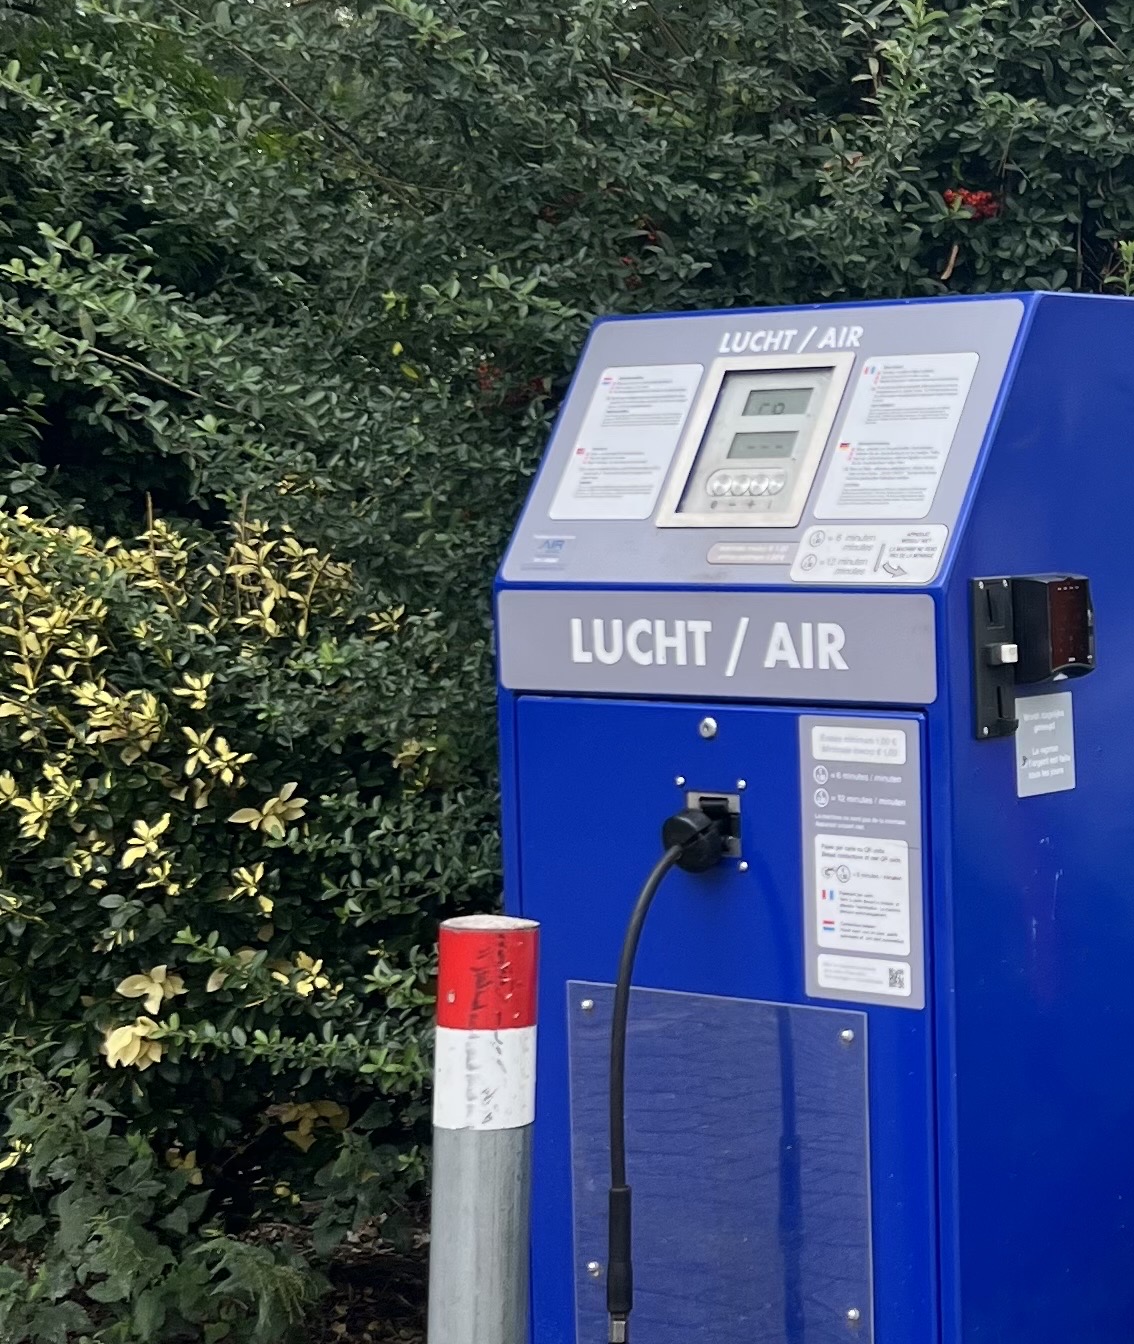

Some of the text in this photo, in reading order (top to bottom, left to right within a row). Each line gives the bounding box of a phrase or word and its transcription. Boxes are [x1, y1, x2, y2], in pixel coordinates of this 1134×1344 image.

[719, 329, 798, 353] LUCHT
[818, 325, 864, 349] AIR
[570, 618, 712, 666] LUCHT
[763, 622, 849, 671] AIR
